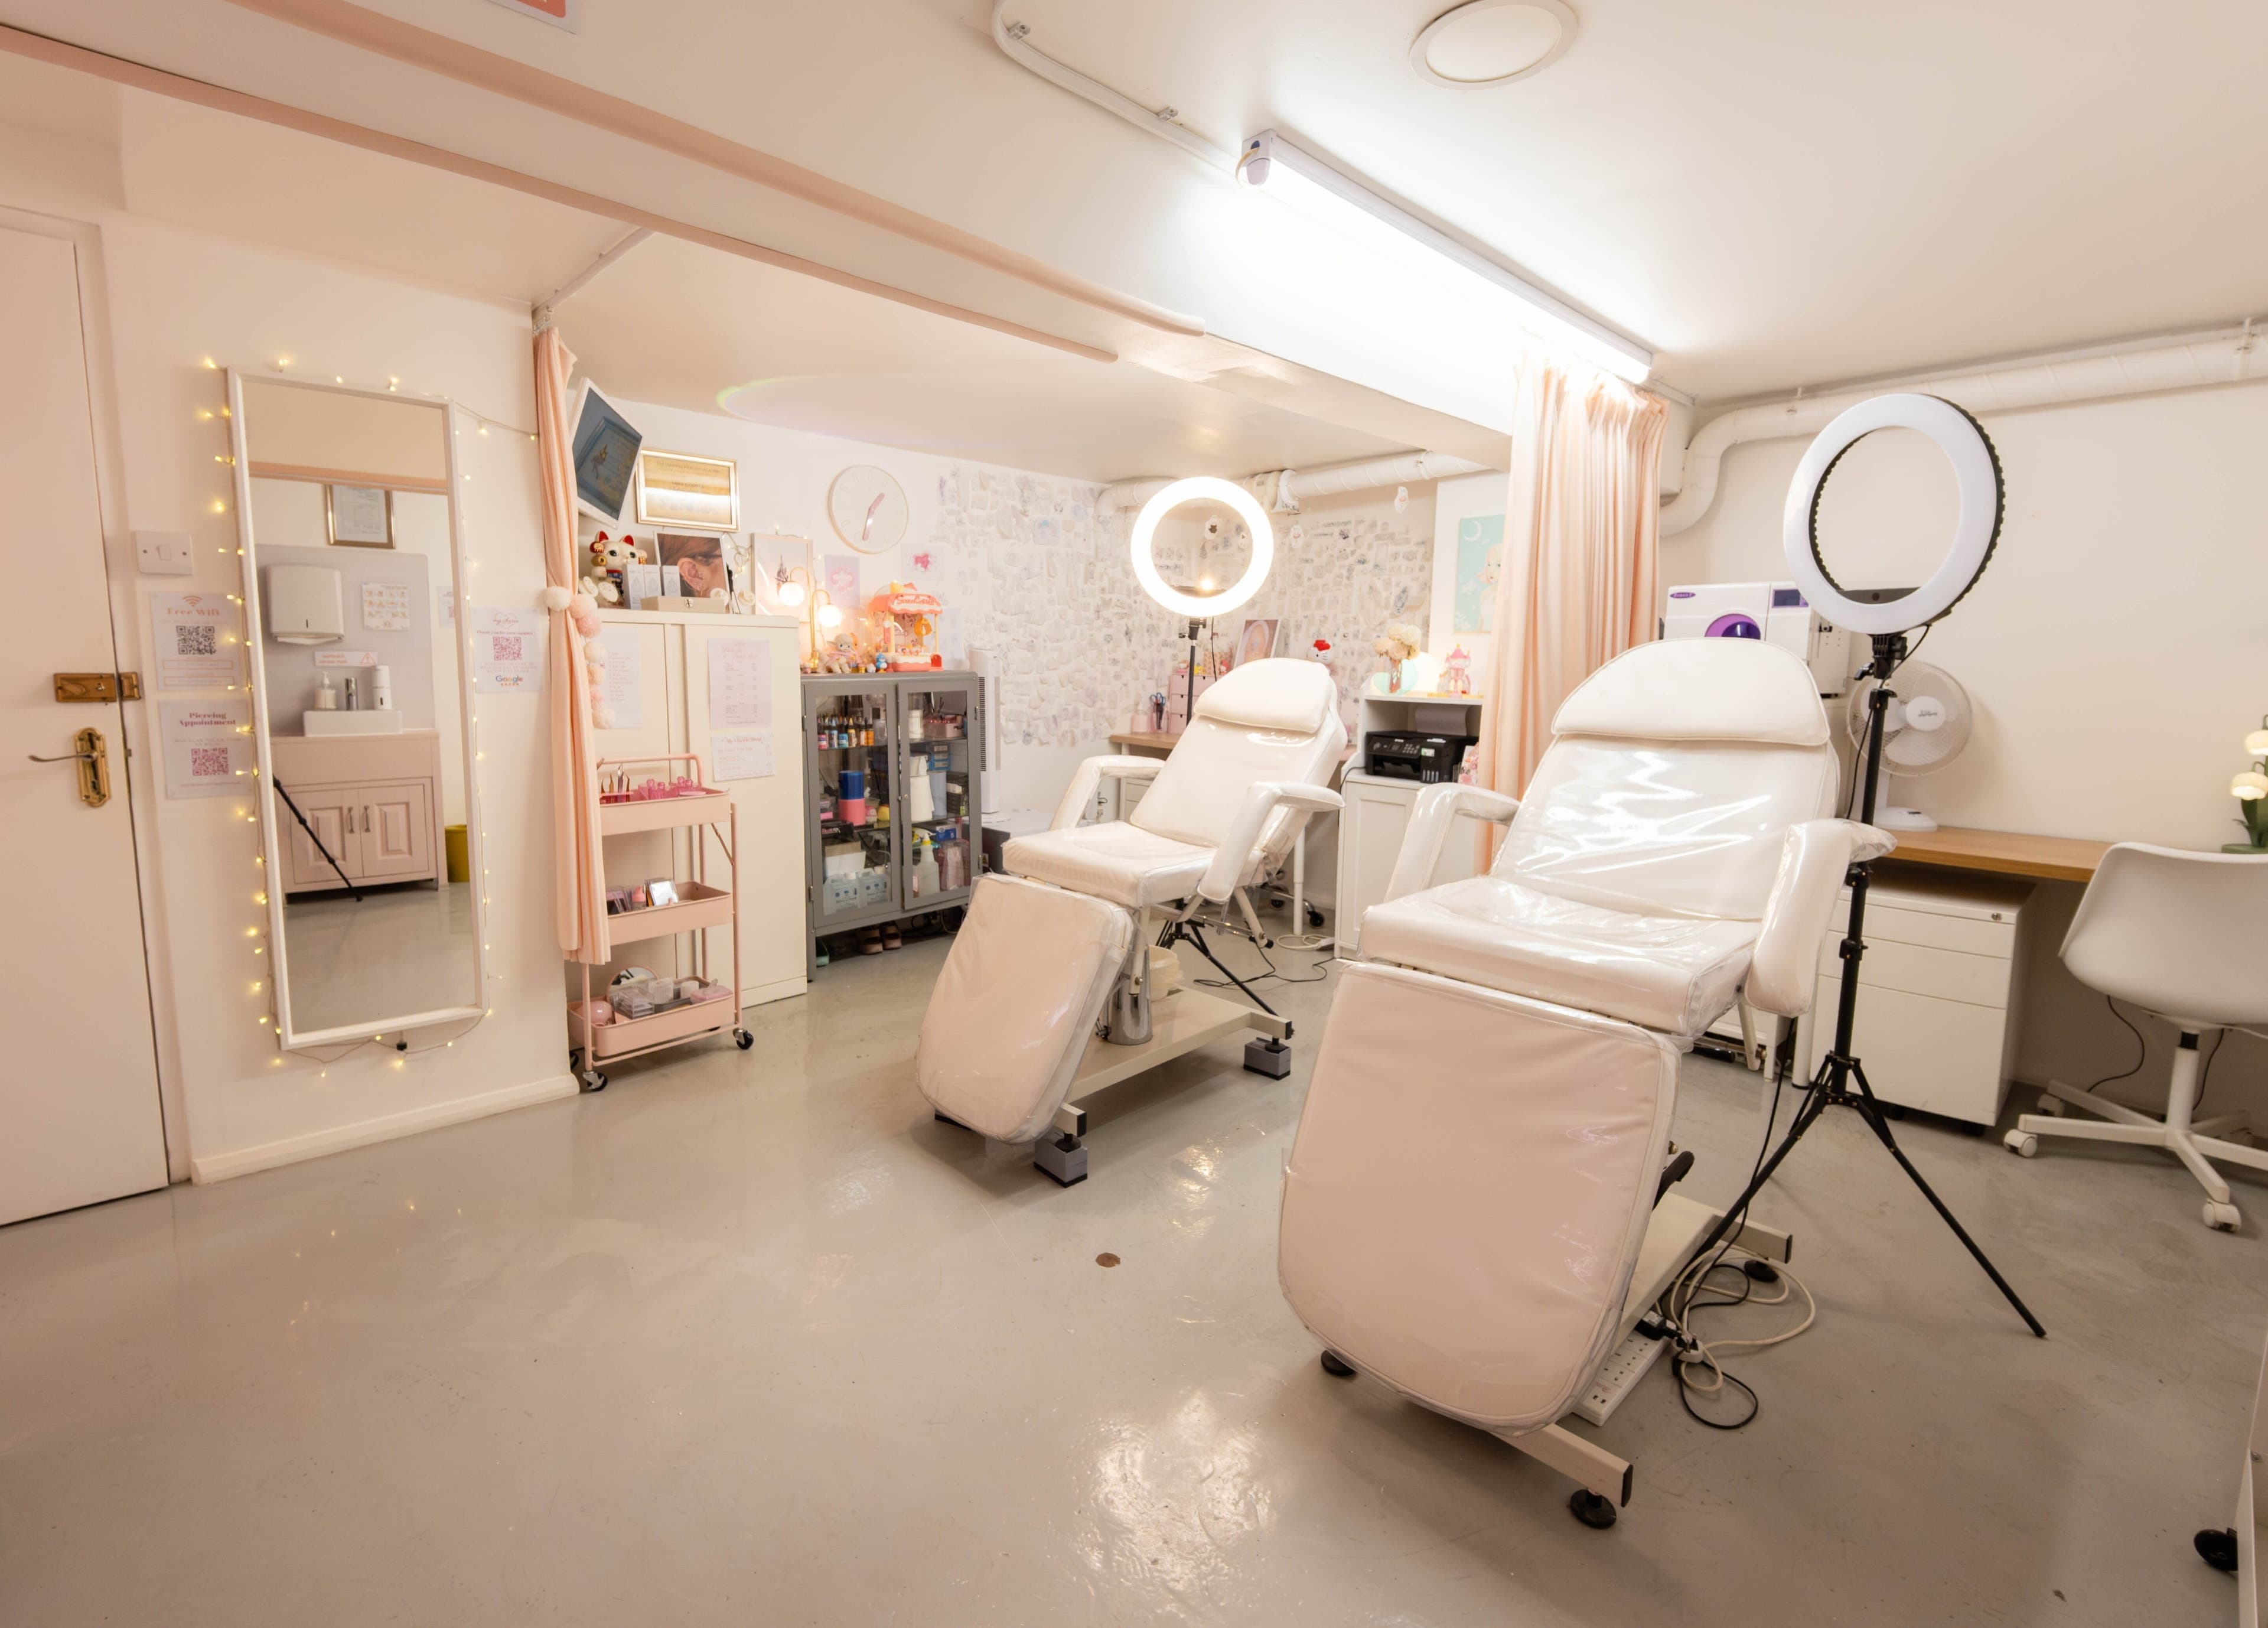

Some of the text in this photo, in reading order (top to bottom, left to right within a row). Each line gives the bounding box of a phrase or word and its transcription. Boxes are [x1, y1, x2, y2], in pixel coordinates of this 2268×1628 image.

[195, 608, 220, 616] Wifi
[496, 675, 523, 683] Google
[179, 719, 236, 728] Appointment
